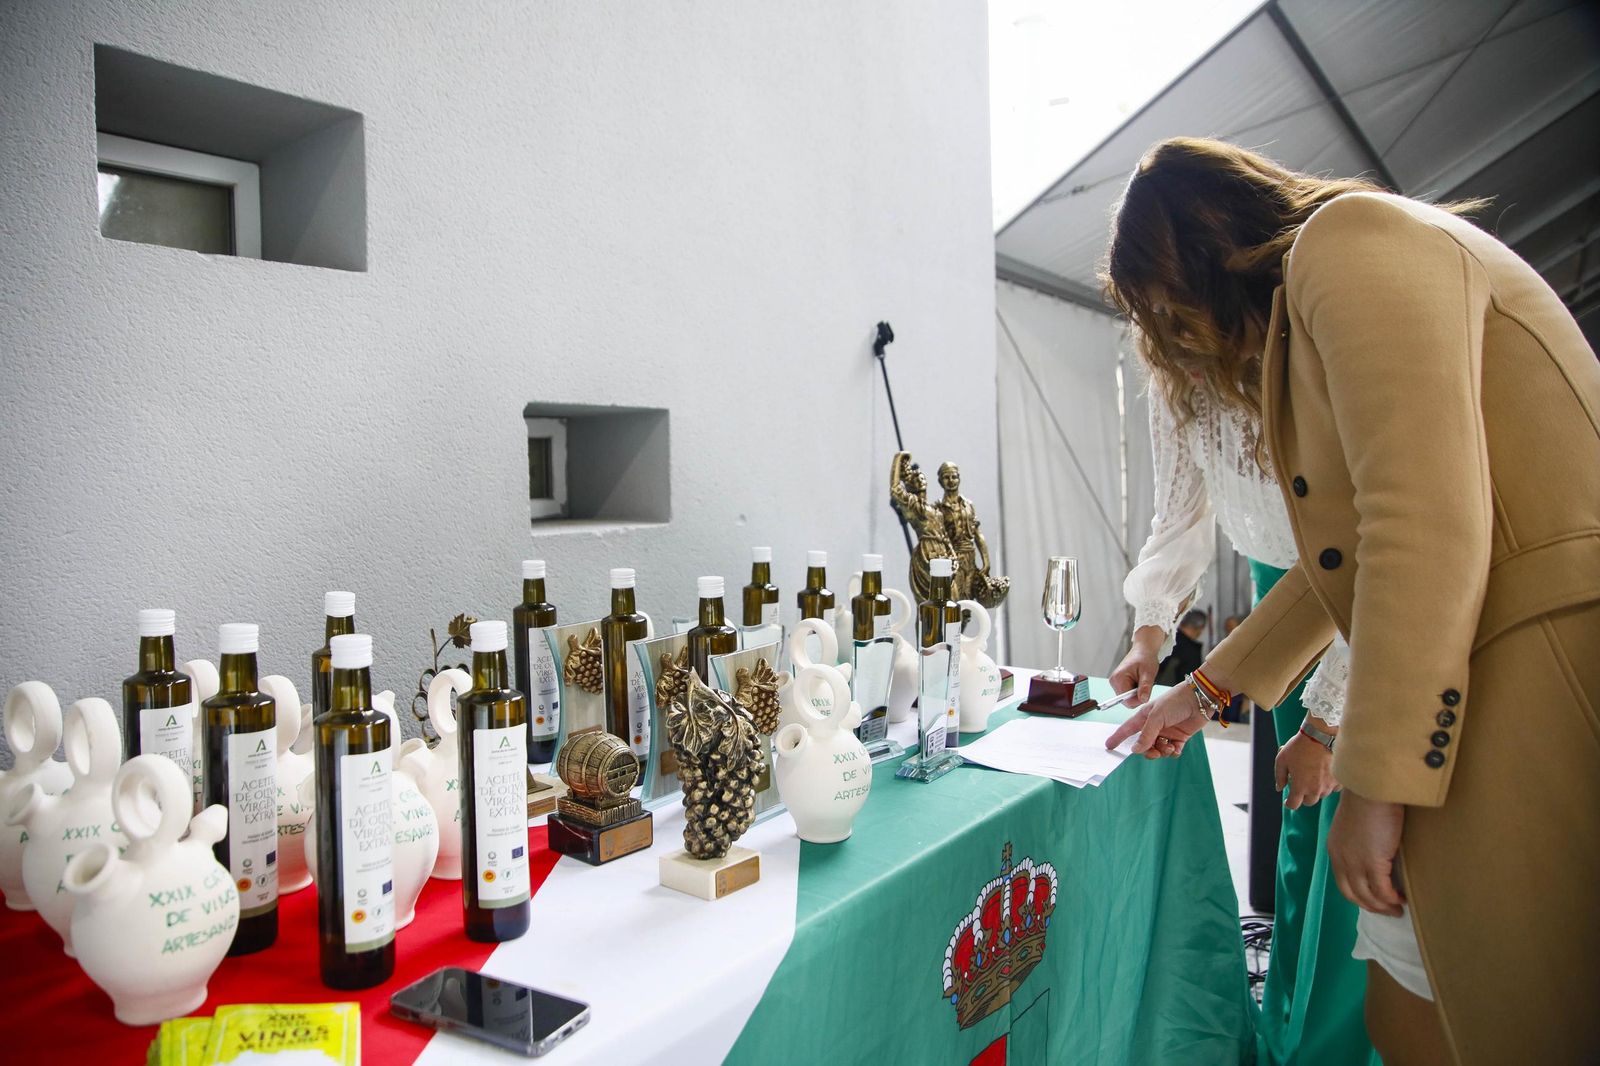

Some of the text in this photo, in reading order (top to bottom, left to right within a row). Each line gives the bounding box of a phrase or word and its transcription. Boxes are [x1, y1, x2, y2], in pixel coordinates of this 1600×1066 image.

[832, 751, 858, 764] XXIX
[842, 769, 857, 782] DE
[62, 825, 101, 841] XXIX
[148, 885, 196, 908] XXIX
[166, 908, 192, 928] DE
[239, 1025, 330, 1043] VINOS
